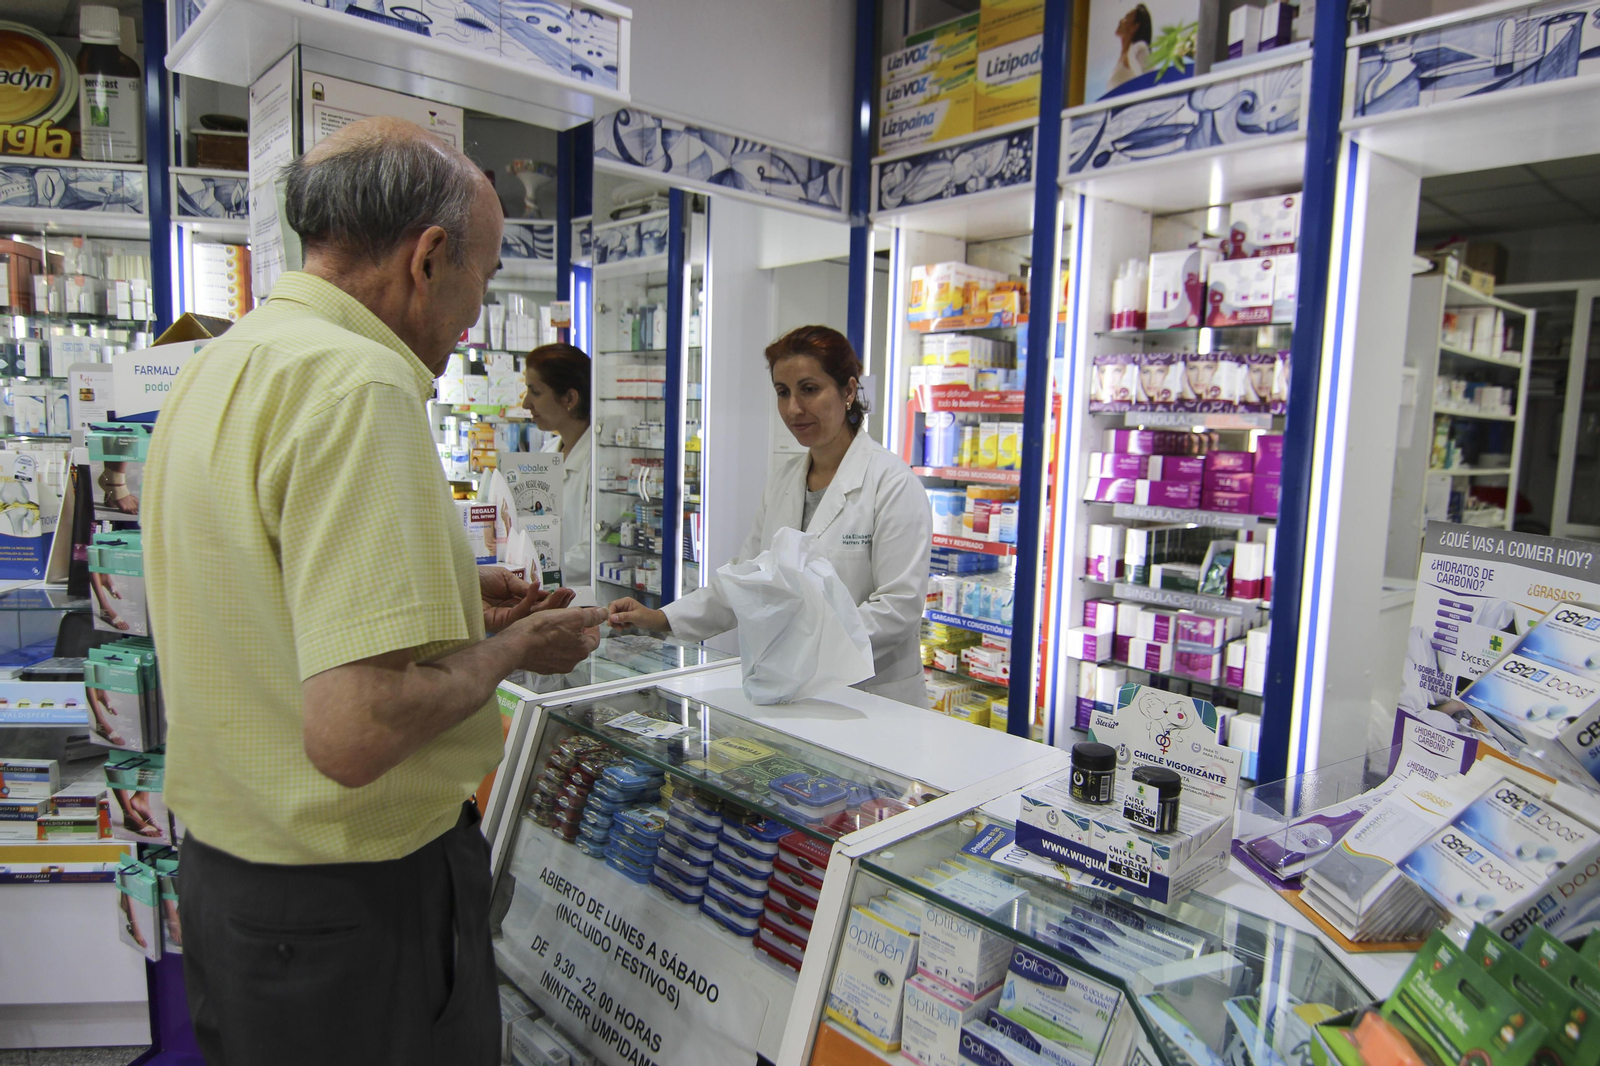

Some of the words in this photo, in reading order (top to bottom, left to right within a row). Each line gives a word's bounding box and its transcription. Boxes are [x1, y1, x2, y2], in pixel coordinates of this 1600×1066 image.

[882, 112, 935, 138] Lizipaina
[946, 469, 957, 477] TOS
[971, 470, 1007, 480] MUCOSIDAD
[933, 536, 949, 545] GRIPE
[954, 539, 985, 550] RESFRIADO
[1439, 530, 1470, 549] ¿QUÉ
[1472, 535, 1495, 553] VAS
[1495, 539, 1505, 555] A
[1507, 541, 1554, 563] COMER
[1556, 548, 1593, 570] HOY?
[1431, 559, 1480, 579] ¿HIDRATOS
[1482, 568, 1495, 582] DE
[1436, 571, 1485, 592] CARBONO?
[932, 613, 961, 625] GARGANTA
[967, 620, 1003, 634] CONGESTIÓN
[1555, 609, 1591, 627] CB12
[1418, 664, 1436, 677] SOBRE
[1420, 673, 1446, 688] BLOQUEA
[1502, 660, 1537, 679] CB12
[1545, 675, 1596, 700] boost
[1428, 682, 1438, 693] LAS
[1095, 717, 1116, 730] Stevia
[1414, 724, 1446, 744] ¿HIDRATOS
[1447, 738, 1456, 749] DE
[1417, 734, 1450, 755] CARBONO?
[1134, 749, 1164, 765] CHICLE
[1166, 759, 1227, 785] VIGORIZANTE
[1495, 788, 1529, 812] CB12
[1536, 811, 1586, 845] boost
[1441, 833, 1473, 858] CB12
[1479, 860, 1525, 894] boost
[926, 909, 976, 942] optibén
[1500, 905, 1544, 943] CB12
[1543, 907, 1565, 930] Mint
[539, 866, 586, 908] ABIERTO
[586, 897, 605, 921] DE
[604, 909, 646, 951] LUNES
[645, 941, 657, 960] A
[659, 949, 719, 1003] SÁBADO
[849, 924, 905, 965] optibén
[555, 902, 612, 953] (INCLUIDO
[614, 945, 681, 1011] FESTIVOS)
[1014, 951, 1064, 986] Opticalm
[531, 935, 550, 957] DE
[553, 952, 576, 980] 9.30
[614, 1003, 662, 1053] HORAS
[540, 970, 591, 1024] ININTERR
[1069, 979, 1088, 993] GOTAS
[908, 993, 957, 1030] optibén
[989, 1016, 1037, 1051] Opticalm
